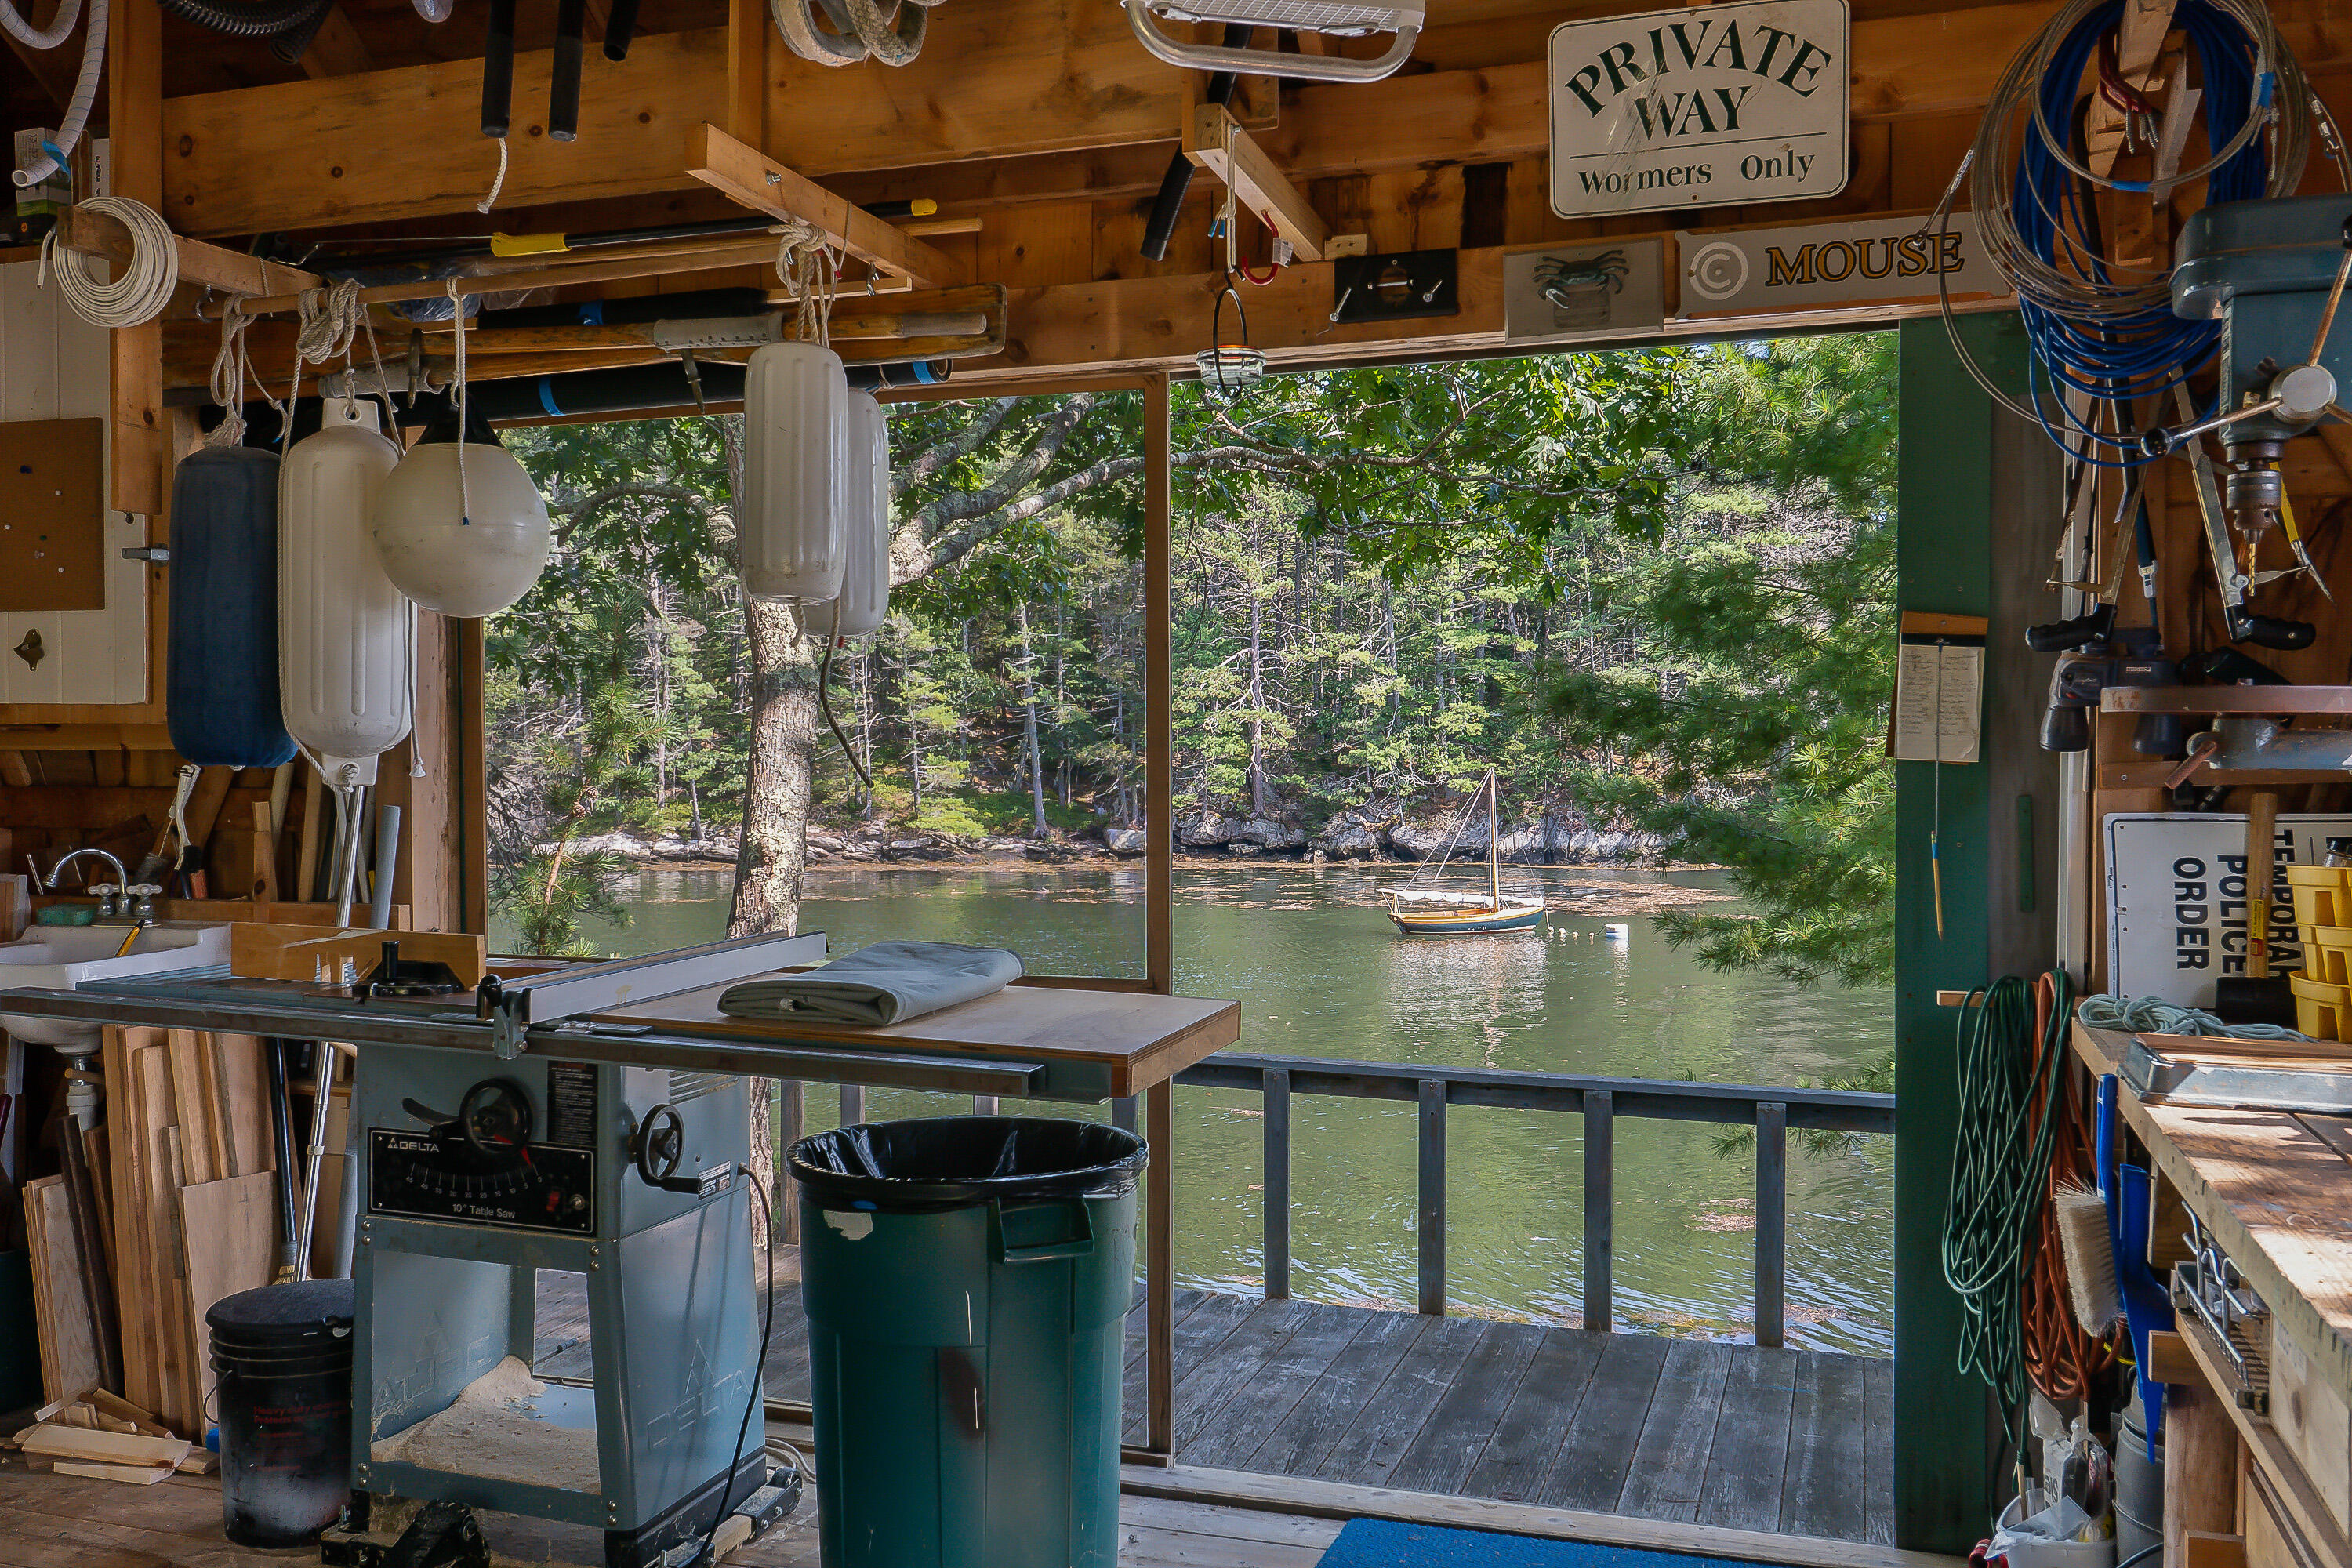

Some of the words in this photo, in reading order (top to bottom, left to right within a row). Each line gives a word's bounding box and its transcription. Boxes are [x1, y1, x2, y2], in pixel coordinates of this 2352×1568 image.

[1564, 18, 1832, 118] PRIVATE
[1634, 85, 1752, 141] WAY
[1577, 163, 1712, 195] Wormers
[1740, 149, 1815, 183] Only
[1765, 232, 1965, 288] MOUSE
[2172, 856, 2210, 971] ORDER
[2217, 855, 2249, 975] POLICE
[399, 1141, 440, 1152] DELTA
[470, 1205, 495, 1217] Table
[496, 1208, 516, 1219] Saw
